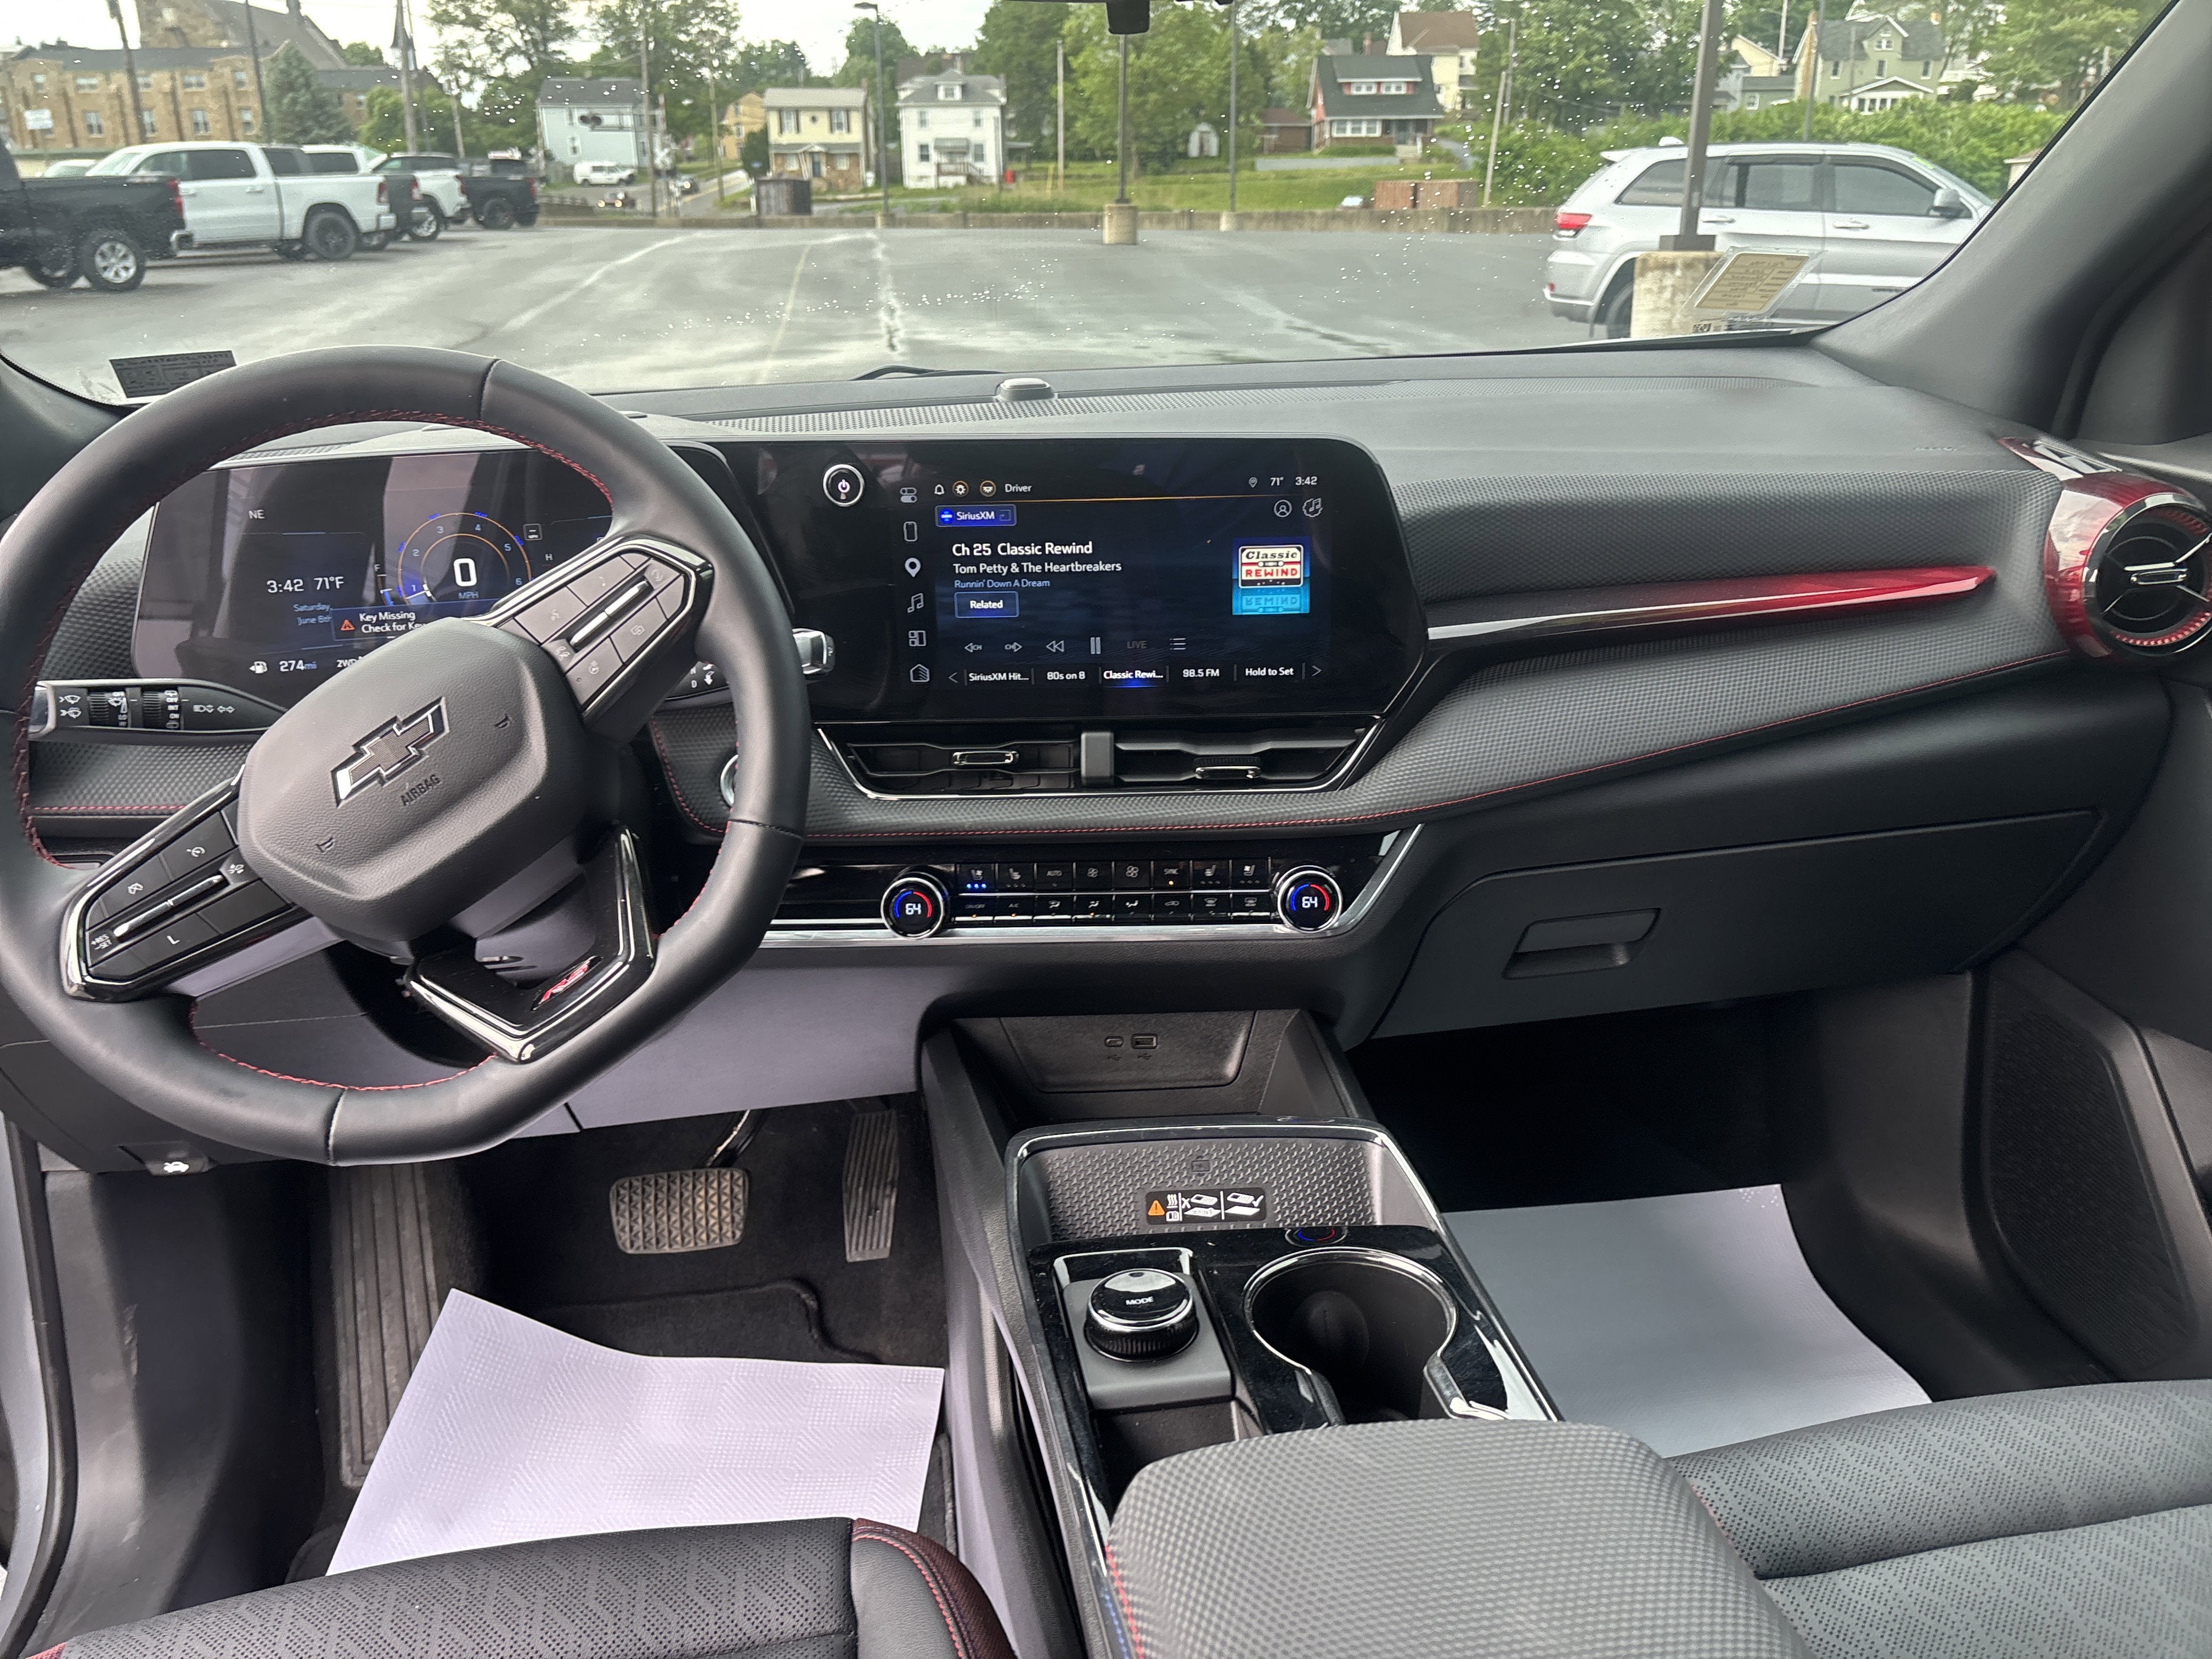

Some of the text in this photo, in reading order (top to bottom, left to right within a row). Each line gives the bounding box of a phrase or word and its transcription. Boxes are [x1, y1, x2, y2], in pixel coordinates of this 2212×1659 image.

[1295, 476, 1317, 486] 3:42
[1005, 483, 1032, 493] Driver
[249, 509, 266, 519] NE
[956, 511, 995, 521] SiriusXM
[437, 526, 444, 534] 3
[952, 541, 1093, 556] Ch 25 Classic Rewind
[1245, 550, 1297, 560] Classic
[454, 558, 477, 587] 0
[953, 561, 1121, 575] Tom Petty & The Heartbreakers
[1245, 568, 1297, 578] REWIND
[267, 576, 344, 593] 3:42 71°F
[987, 579, 1011, 588] Down
[1013, 579, 1020, 588] A
[1022, 578, 1050, 588] Dream
[294, 603, 330, 612] Saturday
[970, 600, 1003, 609] Related
[297, 616, 317, 625] June
[359, 611, 415, 623] Key Missing
[362, 623, 391, 633] Check
[392, 622, 407, 631] for
[1127, 641, 1147, 649] LIVE
[1047, 672, 1064, 680] 80s
[1079, 672, 1085, 680] 8
[1103, 670, 1133, 680] Classic
[1182, 668, 1220, 678] 98.5 FM
[1245, 667, 1294, 676] Hold to Set
[969, 673, 1007, 681] SiriusXM
[691, 680, 697, 688] D
[401, 774, 441, 806] AIRBAG
[1302, 896, 1318, 908] 64
[905, 903, 921, 915] 64
[1126, 1296, 1154, 1305] MODE
